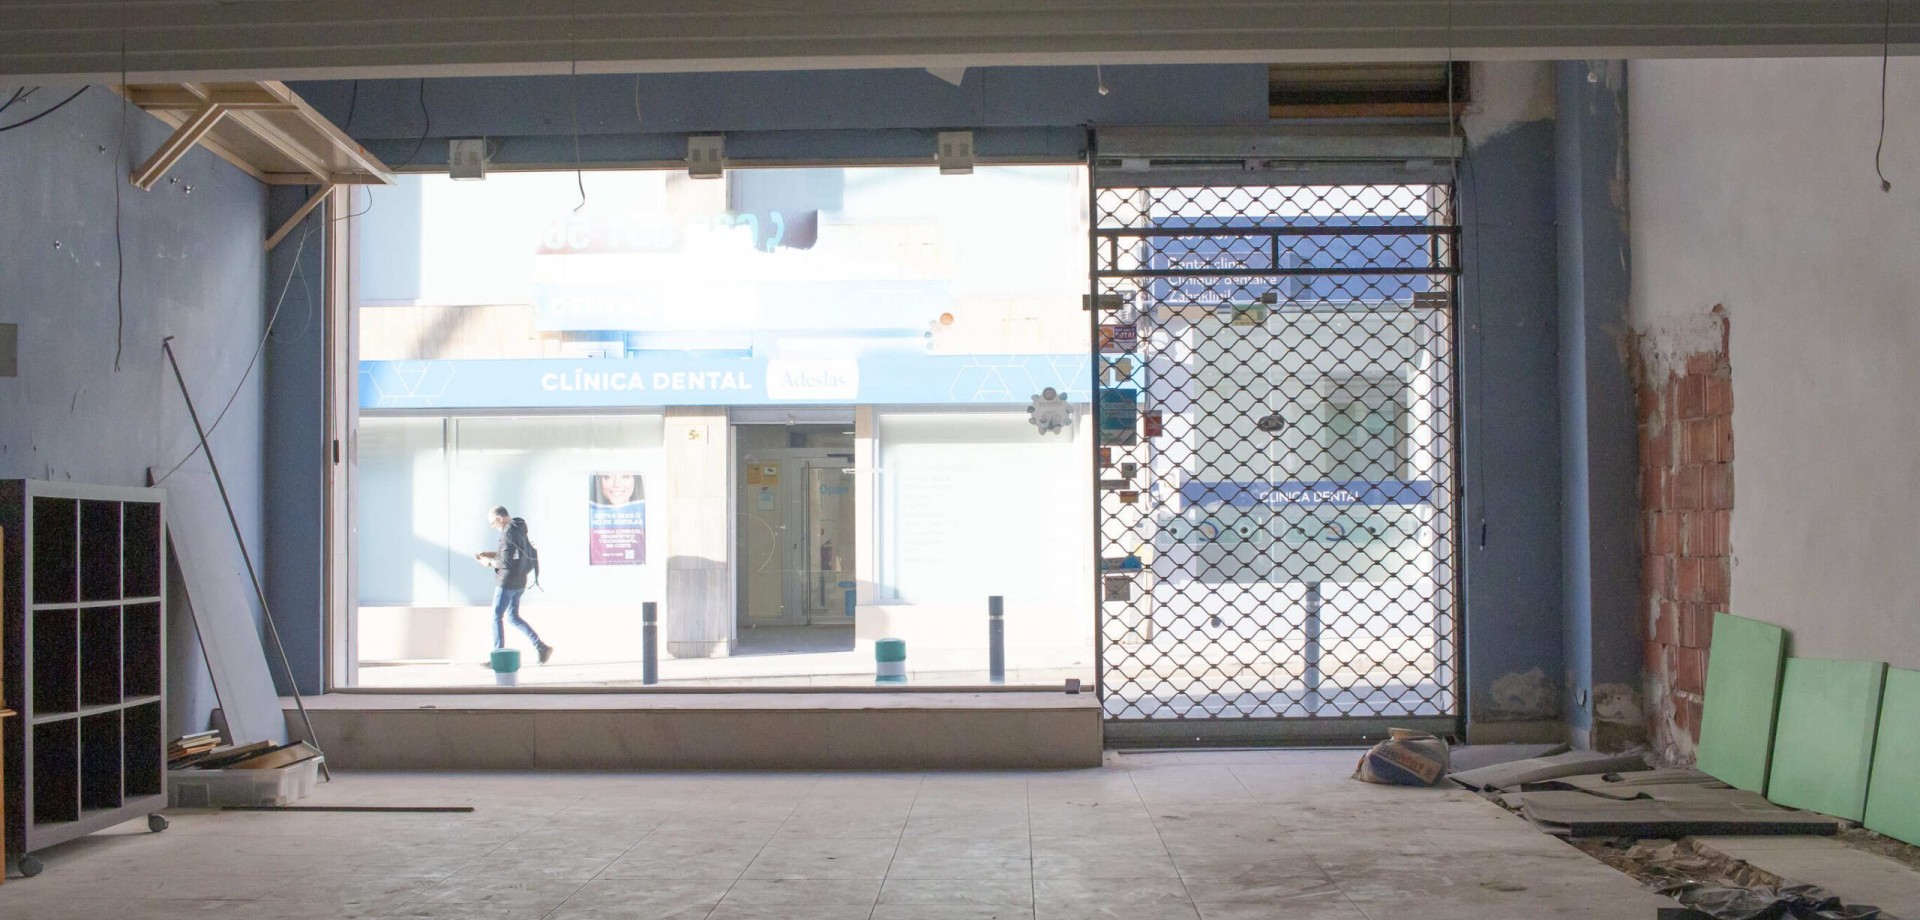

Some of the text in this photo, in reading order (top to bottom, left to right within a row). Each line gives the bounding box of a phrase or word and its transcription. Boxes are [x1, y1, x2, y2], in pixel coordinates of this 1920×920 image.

[1168, 257, 1212, 269] Dental
[541, 367, 752, 392] CLÍNICA DENTAL
[780, 368, 847, 389] Adeslas
[1313, 491, 1359, 502] DENTAL
